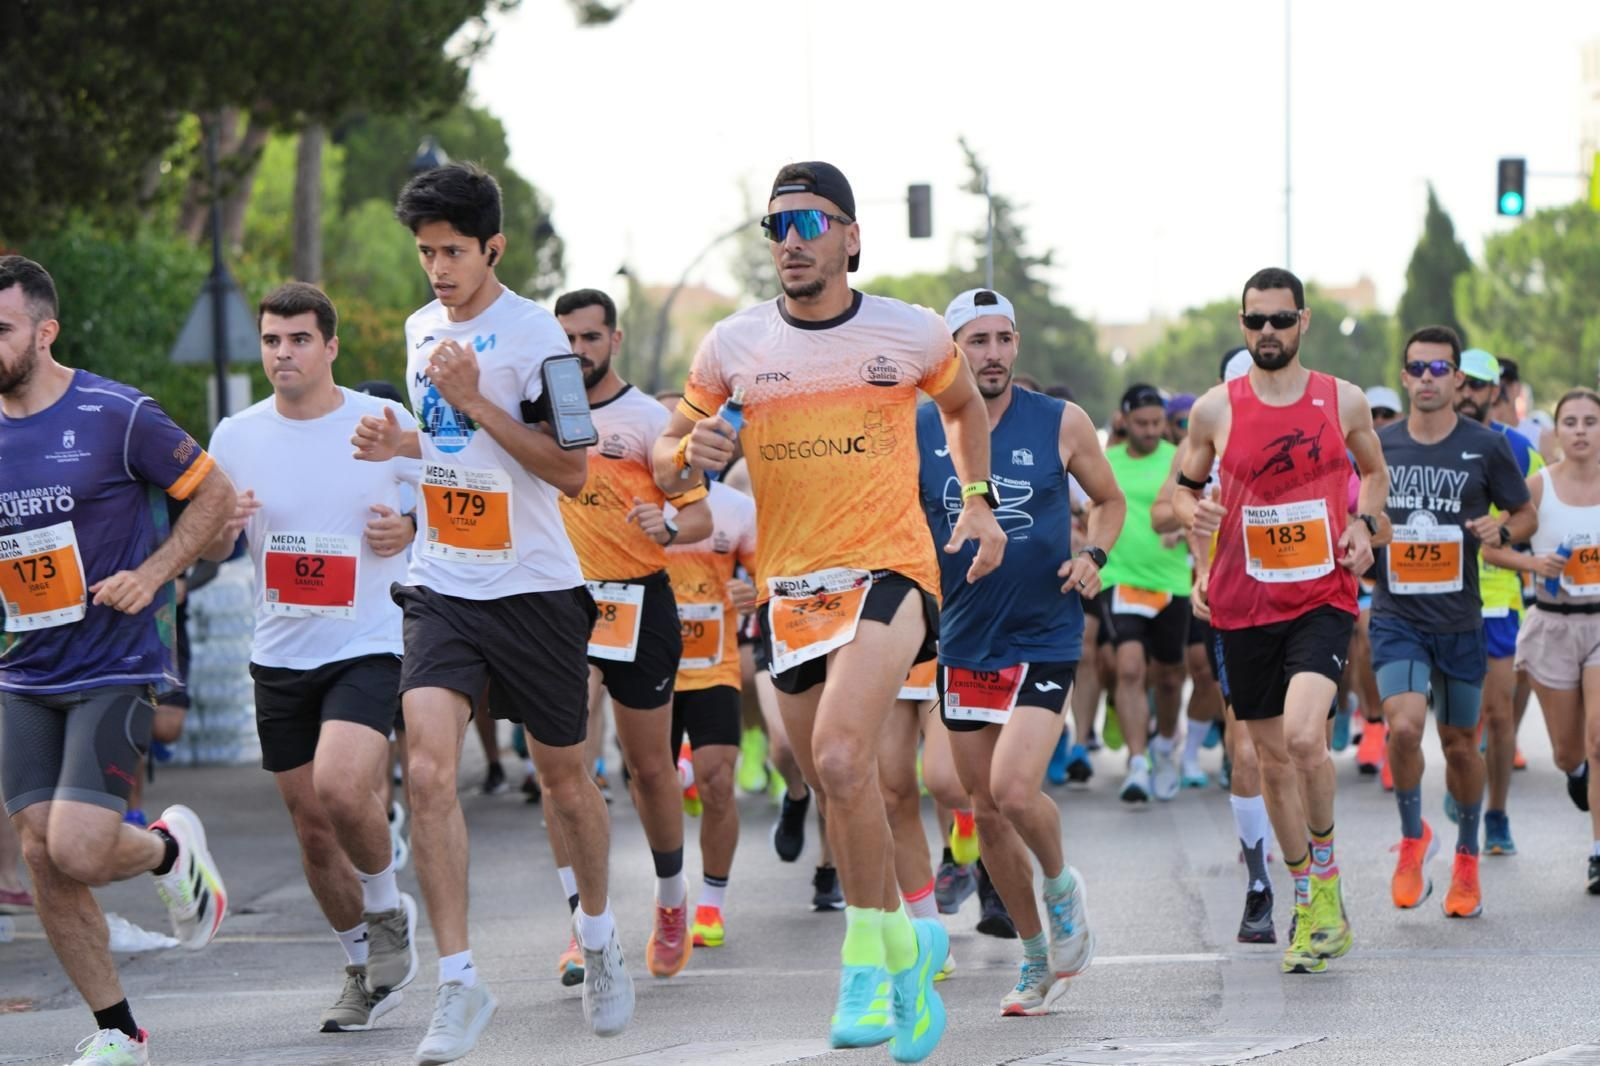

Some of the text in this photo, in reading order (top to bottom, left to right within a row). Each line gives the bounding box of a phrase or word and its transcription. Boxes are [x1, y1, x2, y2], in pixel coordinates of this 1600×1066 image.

[867, 365, 898, 374] Estrella
[868, 372, 897, 380] Galicia
[426, 465, 457, 479] MEDIA
[1388, 465, 1469, 500] NAVY
[20, 484, 72, 500] MARATÓN
[443, 491, 486, 517] 179
[1387, 496, 1461, 513] SINCE 1775
[1248, 509, 1278, 518] MEDIA
[0, 517, 23, 528] AVAL
[271, 535, 306, 544] MEDIA
[1265, 525, 1307, 545] 183
[0, 539, 20, 551] DIA
[1404, 545, 1441, 561] 475
[12, 556, 56, 583] 173
[295, 556, 325, 578] 62
[774, 579, 810, 592] MEDIA
